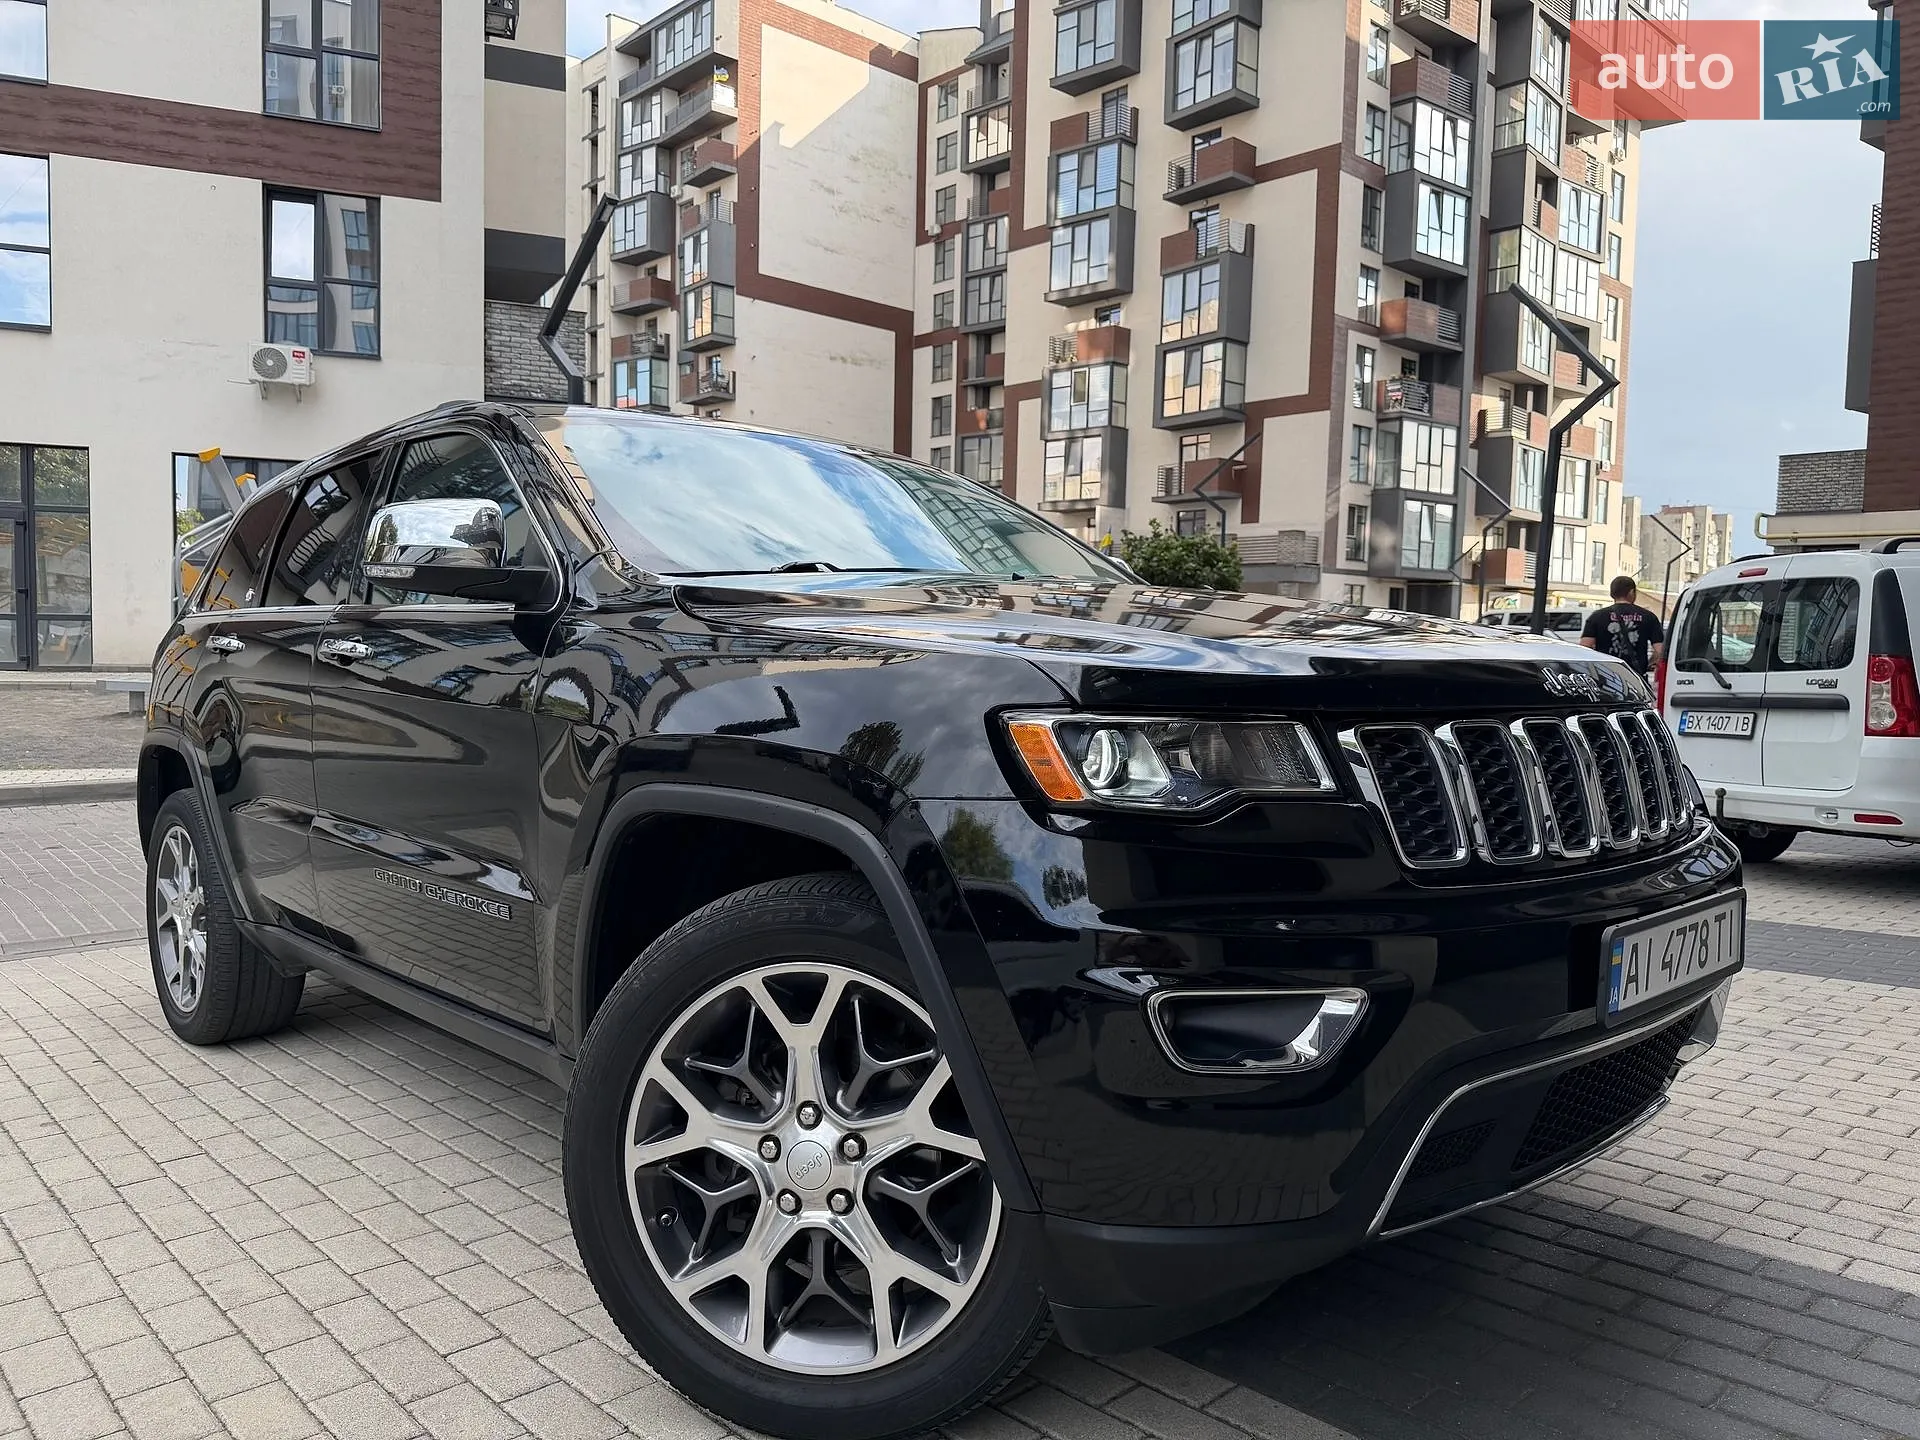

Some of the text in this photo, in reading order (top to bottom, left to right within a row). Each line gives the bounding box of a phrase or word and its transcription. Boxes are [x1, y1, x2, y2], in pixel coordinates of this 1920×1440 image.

[1686, 715, 1750, 732] BX 1407 IB
[374, 868, 512, 920] GRAND CHEROKEE
[1622, 909, 1733, 1001] AI 4778 TI
[794, 1151, 823, 1180] Jeep
